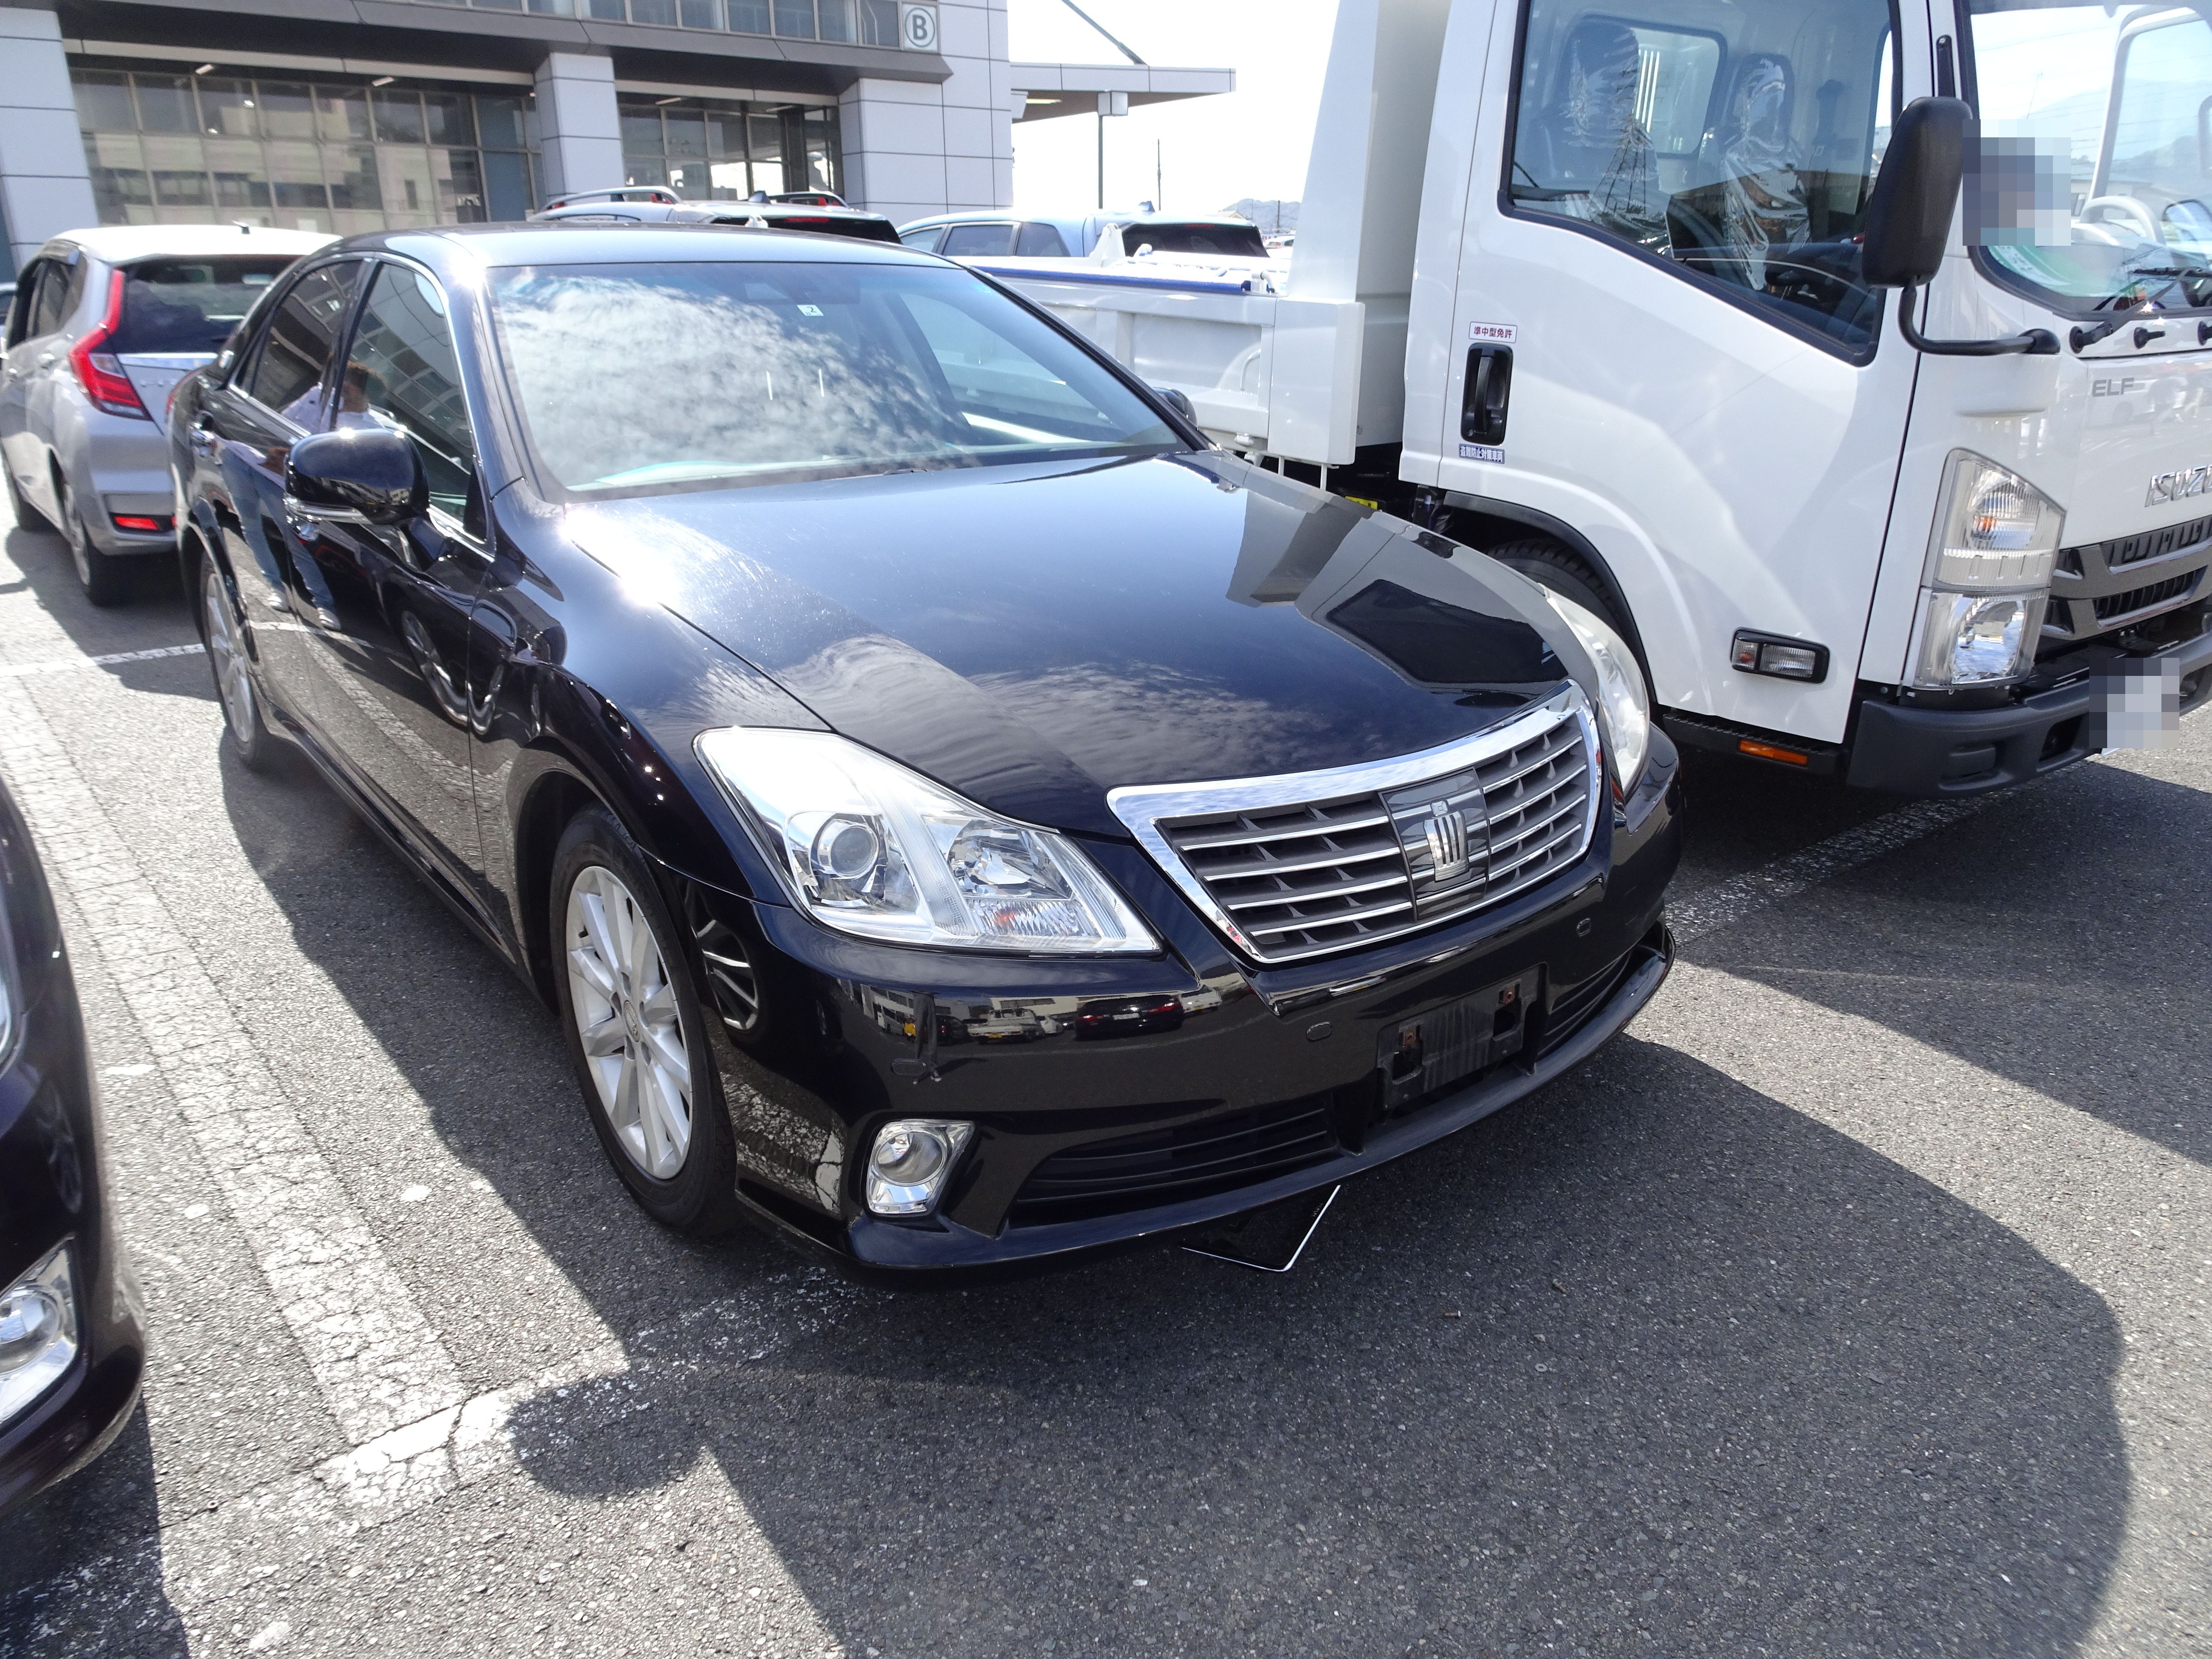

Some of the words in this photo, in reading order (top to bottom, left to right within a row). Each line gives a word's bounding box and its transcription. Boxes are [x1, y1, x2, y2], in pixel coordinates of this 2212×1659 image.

[913, 15, 928, 39] B
[1473, 326, 1513, 339] 準中型免許
[2092, 377, 2134, 397] ELF
